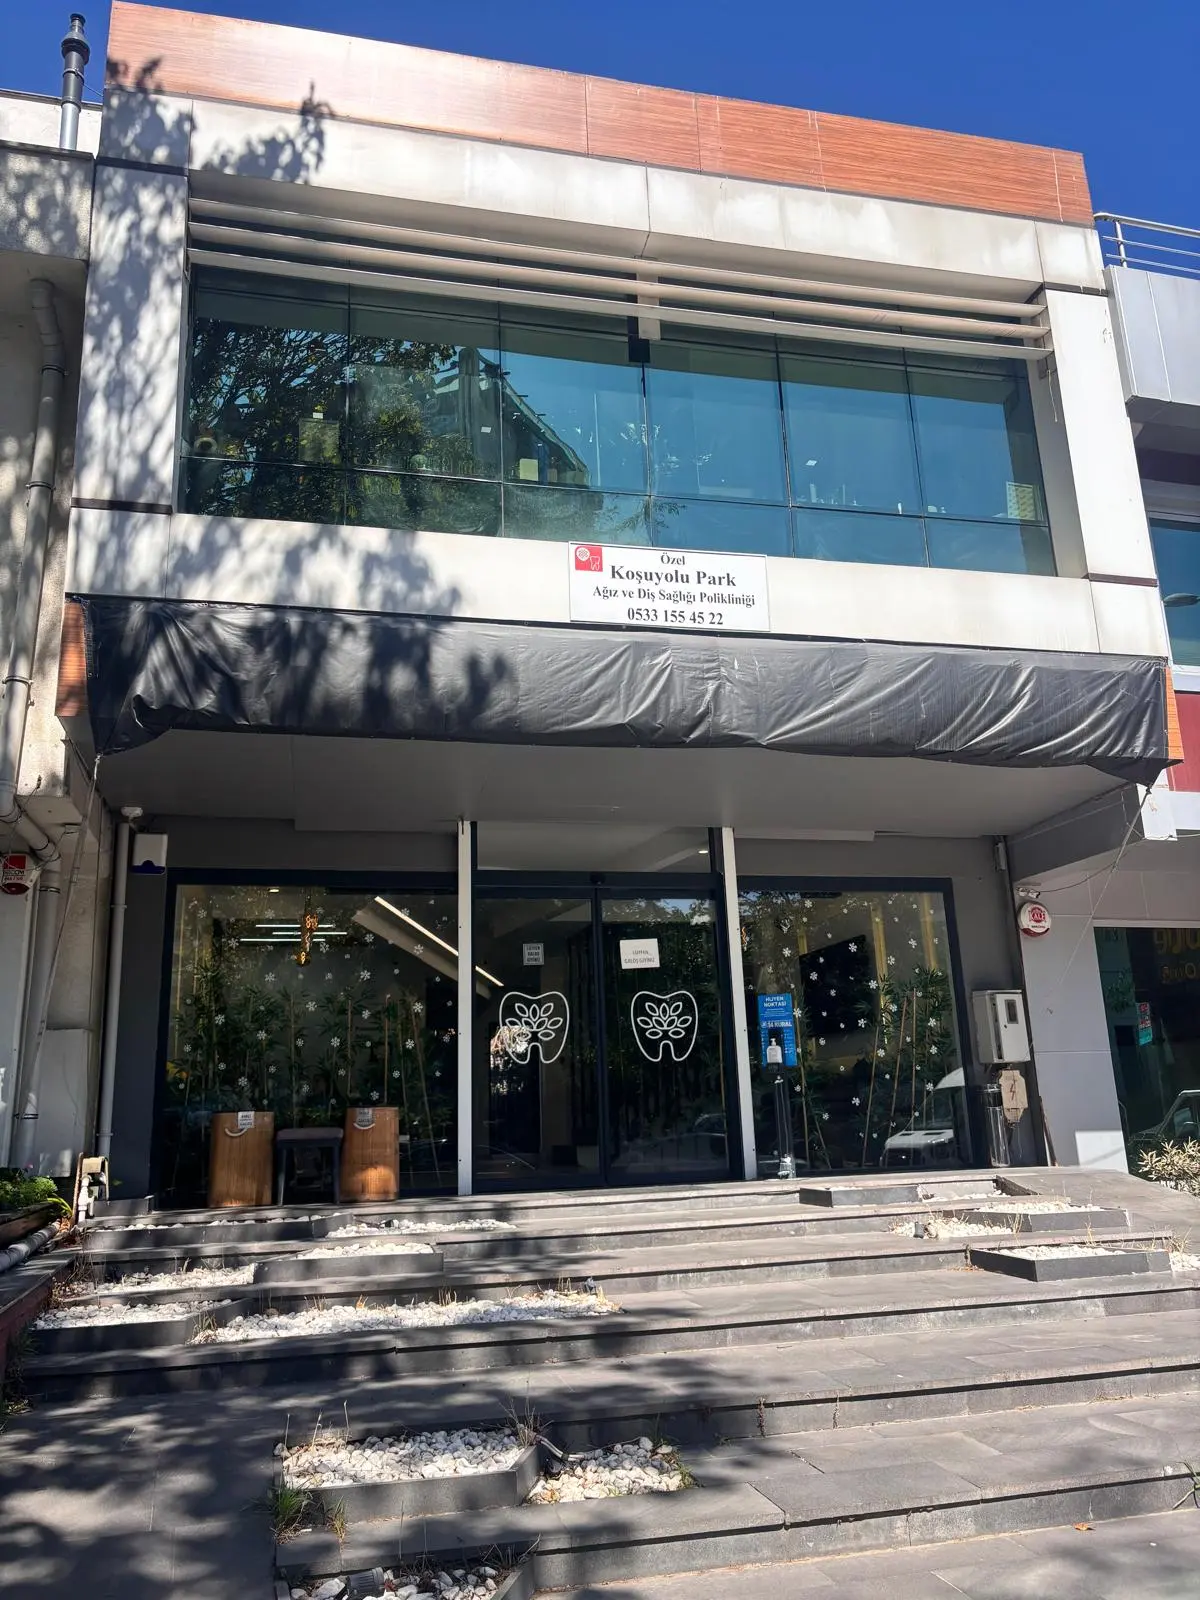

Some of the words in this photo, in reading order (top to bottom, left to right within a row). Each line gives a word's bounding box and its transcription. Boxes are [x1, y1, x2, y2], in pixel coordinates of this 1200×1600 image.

[660, 552, 686, 566] Özel
[610, 564, 690, 586] Koşuyolu
[696, 570, 737, 587] Park
[592, 585, 619, 600] Ağız
[622, 589, 634, 599] ve
[638, 587, 656, 603] Diş
[658, 589, 696, 605] Sağlığı
[699, 591, 756, 608] Polikliniği
[627, 607, 658, 622] 0533
[663, 609, 686, 624] 155
[689, 611, 705, 625] 45
[708, 612, 724, 625] 22
